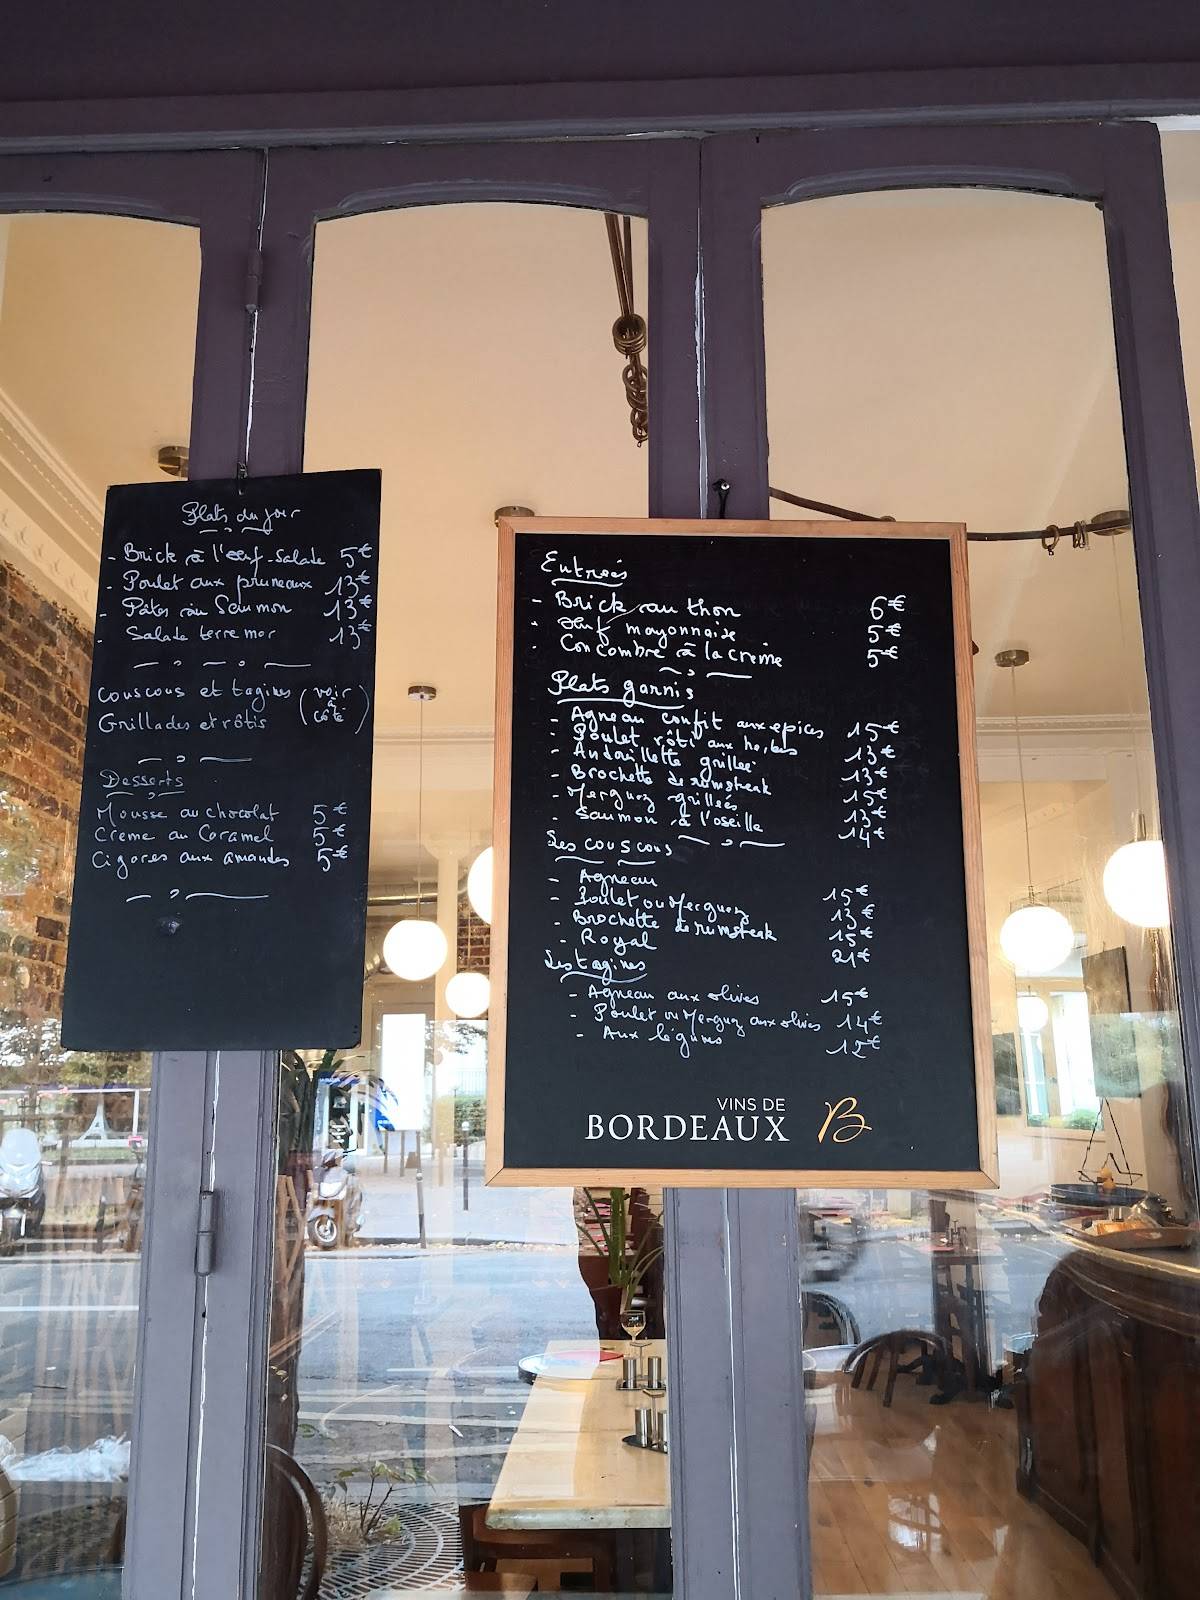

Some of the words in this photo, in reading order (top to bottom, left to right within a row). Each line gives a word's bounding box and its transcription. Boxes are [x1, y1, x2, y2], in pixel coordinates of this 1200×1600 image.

[181, 501, 228, 525] Plats
[236, 508, 258, 522] du
[123, 542, 178, 563] Brick
[340, 543, 373, 568] 5€
[123, 569, 184, 592] Poulet
[189, 577, 225, 590] aux
[236, 574, 313, 605] pruneaux
[324, 570, 371, 598] 13€
[214, 594, 293, 616] Saumon
[323, 596, 373, 620] 13€
[555, 589, 627, 613] Brick
[688, 597, 742, 619] thon
[869, 594, 907, 621] 6€
[126, 626, 188, 643] Salade
[200, 625, 239, 640] terre
[329, 620, 372, 649] 13€
[625, 621, 737, 650] mayonnaise
[867, 622, 902, 644] 5€
[705, 641, 724, 660] la
[866, 645, 899, 668] 5€
[200, 680, 223, 697] et
[231, 678, 291, 712] tagines
[547, 670, 610, 698] Plats
[623, 679, 694, 708] garnis
[98, 712, 190, 733] Grillades
[200, 713, 218, 730] et
[222, 714, 267, 731] rôtis
[571, 706, 645, 733] Agneau
[661, 708, 724, 740] confit
[736, 719, 766, 731] aux
[846, 720, 900, 742] 15€
[573, 723, 642, 748] Poulet
[707, 739, 734, 750] aux
[844, 744, 896, 766] 13€
[100, 769, 184, 789] Desserts
[571, 763, 653, 787] Brochette
[667, 770, 684, 787] de
[842, 787, 888, 807] 15€
[840, 766, 888, 786] 13€
[96, 802, 167, 827] Mousse
[180, 807, 200, 819] au
[312, 802, 348, 825] 5€
[575, 806, 658, 825] Saumon
[701, 808, 764, 833] l'oseille
[838, 826, 885, 849] 14€
[843, 805, 887, 828] 13€
[168, 830, 188, 841] au
[312, 824, 345, 846] 5€
[546, 830, 576, 852] Les
[180, 852, 213, 863] aux
[223, 849, 290, 867] amandes
[317, 845, 348, 872] 5€
[579, 869, 658, 896] Agneau
[822, 884, 869, 906] 15€
[574, 885, 639, 907] Poulet
[643, 899, 665, 911] ou
[830, 903, 876, 930] 13€
[572, 908, 660, 931] Brochette
[674, 917, 690, 933] de
[828, 926, 874, 947] 15€
[580, 931, 658, 956] Royal
[831, 948, 871, 968] 21€
[574, 948, 646, 985] tagines
[587, 984, 655, 1009] Agneau
[667, 991, 701, 1002] aux
[707, 984, 760, 1005] olives
[820, 987, 869, 1007] 15€
[593, 1002, 658, 1023] Poulet
[749, 1015, 778, 1027] aux
[836, 1010, 883, 1035] 14€
[602, 1024, 639, 1041] Aux
[716, 1097, 757, 1112] VINS
[762, 1097, 786, 1112] DE
[585, 1114, 790, 1142] BORDEAUX
